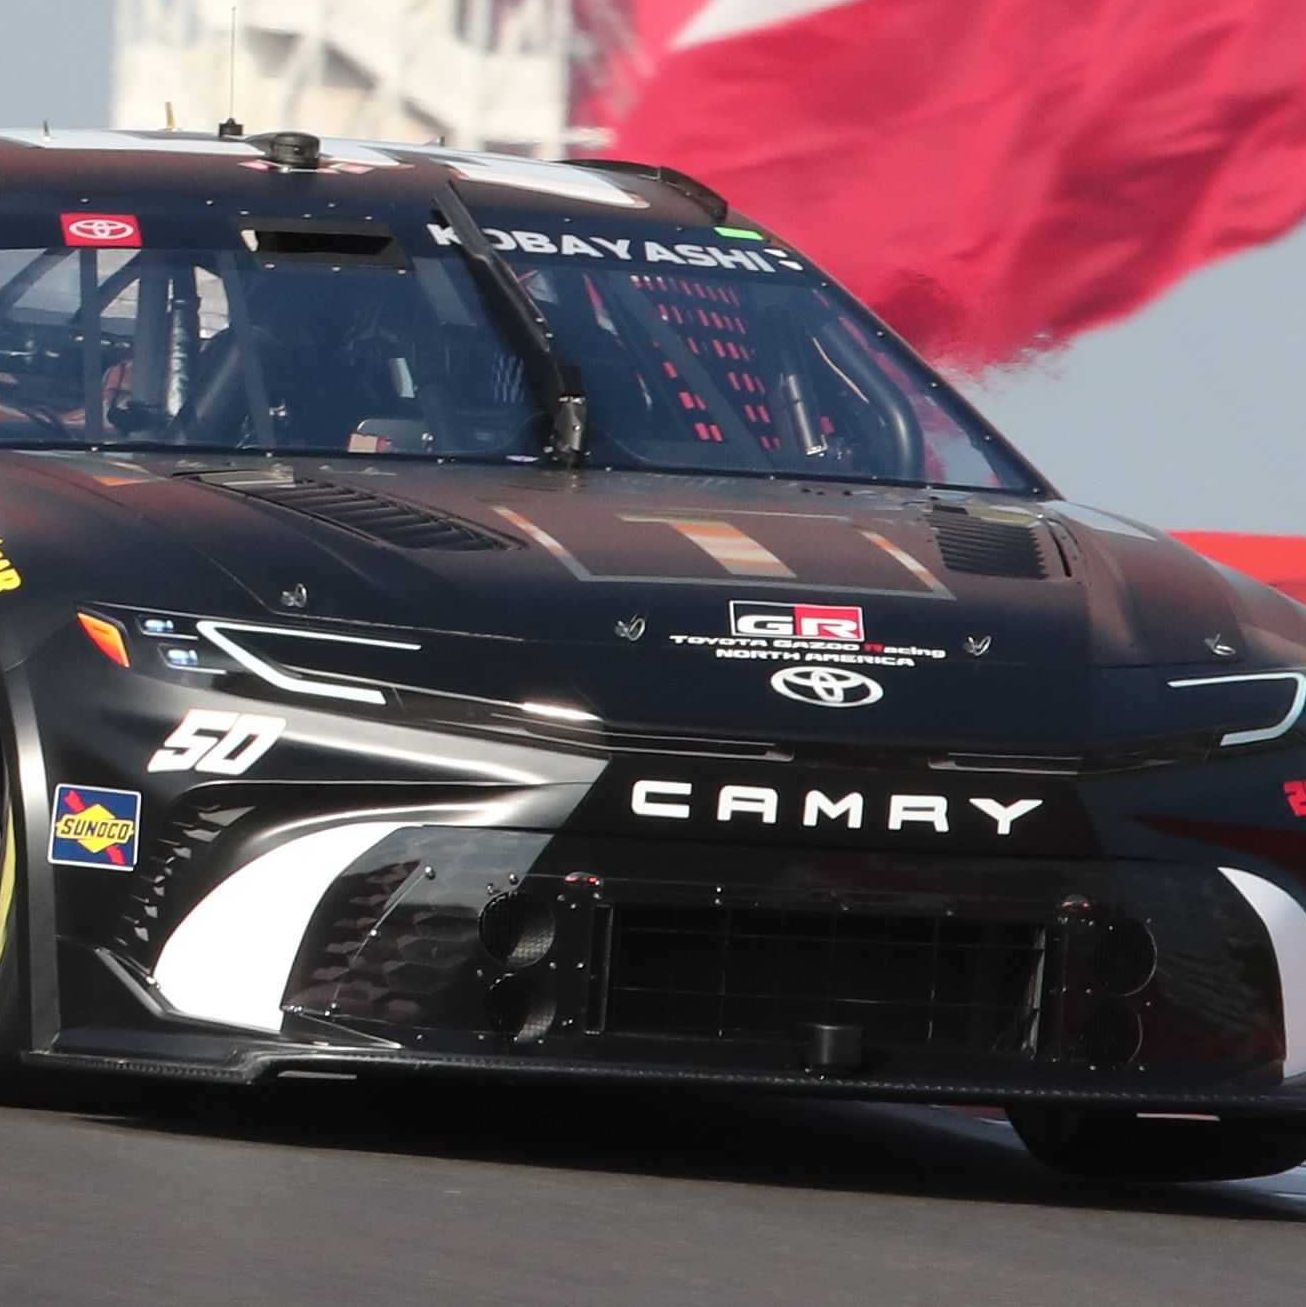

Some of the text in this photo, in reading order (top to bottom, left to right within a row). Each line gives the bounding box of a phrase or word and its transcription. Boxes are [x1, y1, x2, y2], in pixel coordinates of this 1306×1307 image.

[427, 223, 776, 273] KOBAYASHI
[737, 615, 859, 639] GR
[669, 635, 947, 659] TOYOTA GAZOO Racing
[715, 649, 916, 667] NORTH AMERICA
[146, 708, 287, 775] 50
[631, 779, 1044, 835] CAMRY
[60, 818, 131, 841] SUNOCO
